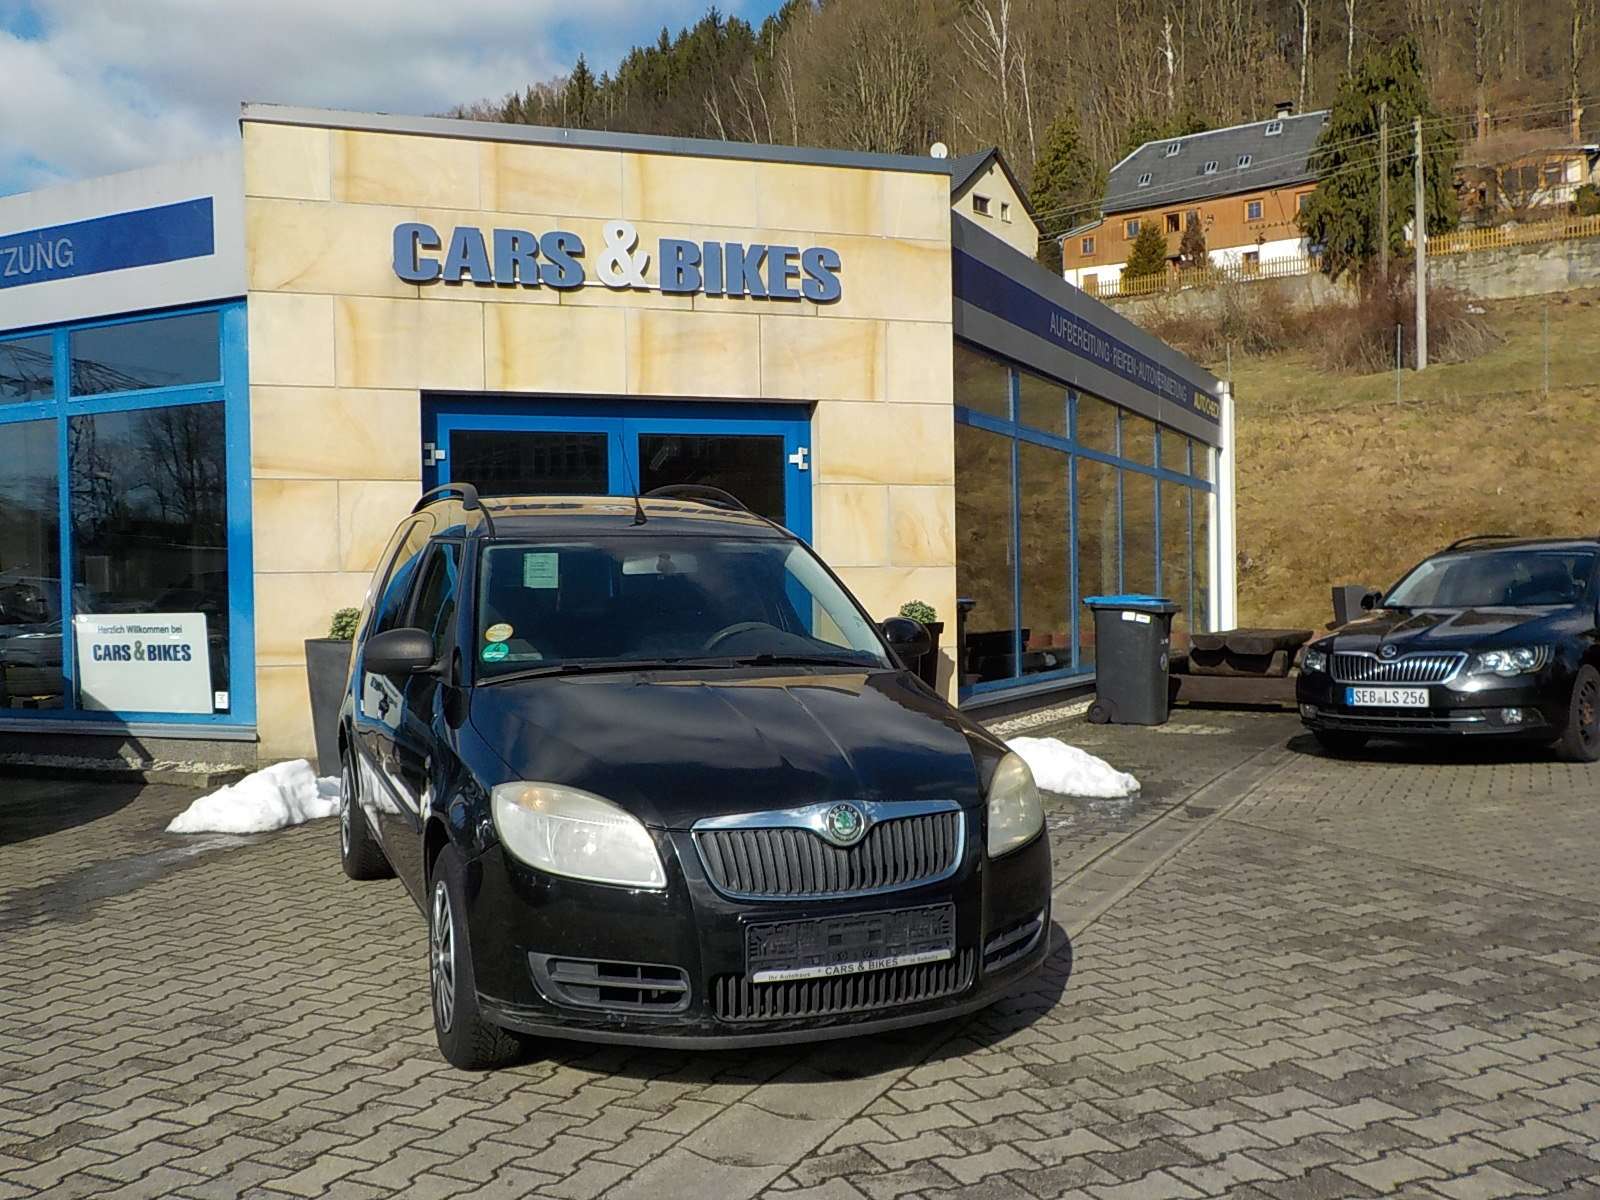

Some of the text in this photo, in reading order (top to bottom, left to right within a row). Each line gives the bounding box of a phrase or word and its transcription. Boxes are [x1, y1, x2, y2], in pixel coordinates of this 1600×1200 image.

[0, 238, 74, 277] ZUNG
[393, 219, 841, 302] CARS & BIKES
[97, 625, 183, 634] Herzlich Willkommen bei
[93, 640, 192, 662] CARS & BIKES
[1355, 690, 1426, 705] SEB LS 256
[825, 964, 855, 976] CARS
[868, 959, 898, 970] BIKES
